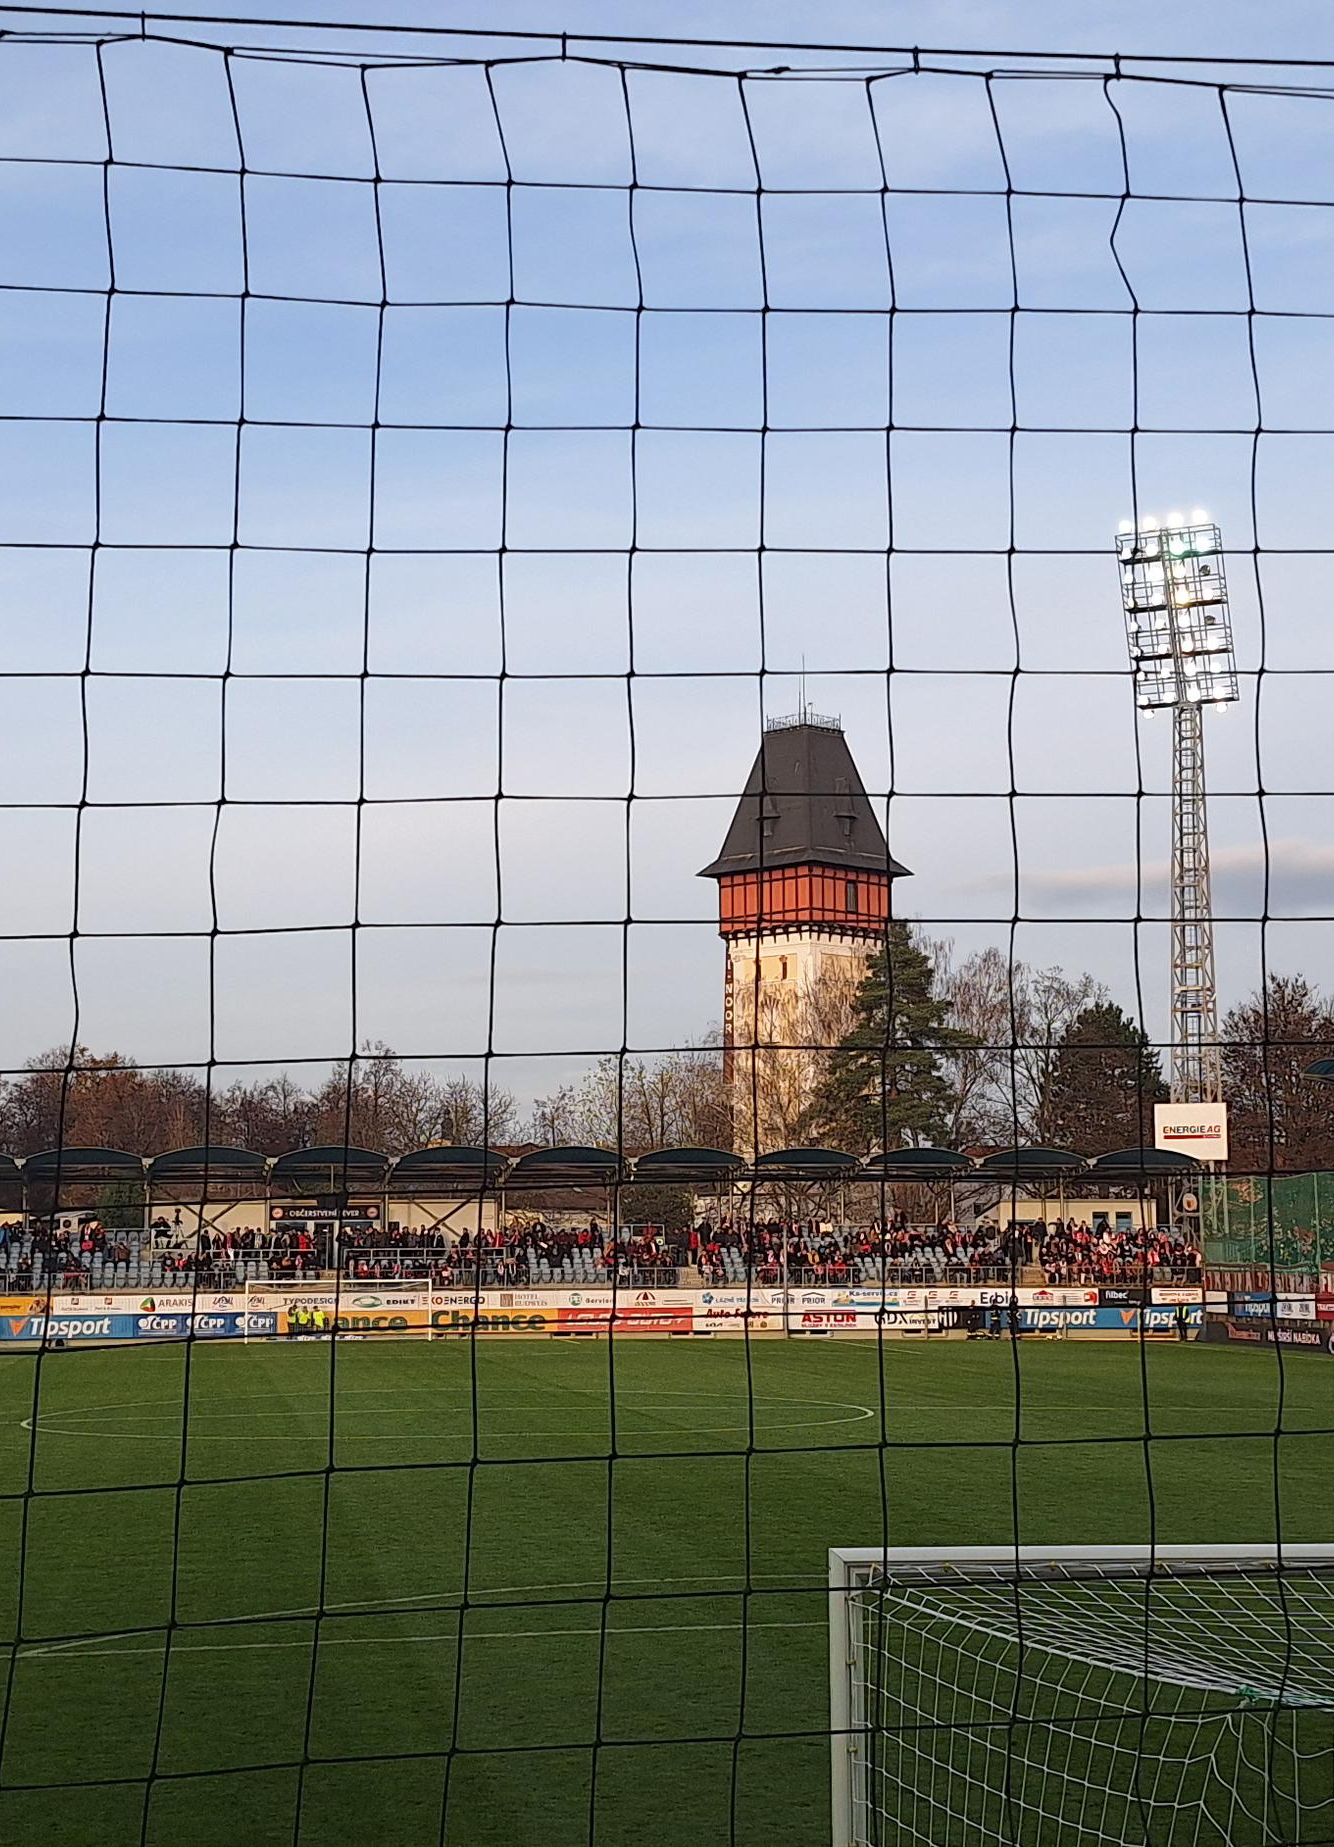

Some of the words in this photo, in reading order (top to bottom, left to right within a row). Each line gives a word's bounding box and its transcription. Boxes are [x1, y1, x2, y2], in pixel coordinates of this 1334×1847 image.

[1162, 1125, 1206, 1134] ENERGIE
[1207, 1125, 1221, 1133] AG
[339, 1209, 360, 1217] EVER
[282, 1297, 339, 1305] TYPODESIG
[802, 1296, 826, 1305] PRIOR
[431, 1310, 547, 1331] Chance
[1024, 1308, 1097, 1328] Tipsport
[30, 1316, 112, 1339] Tipsport
